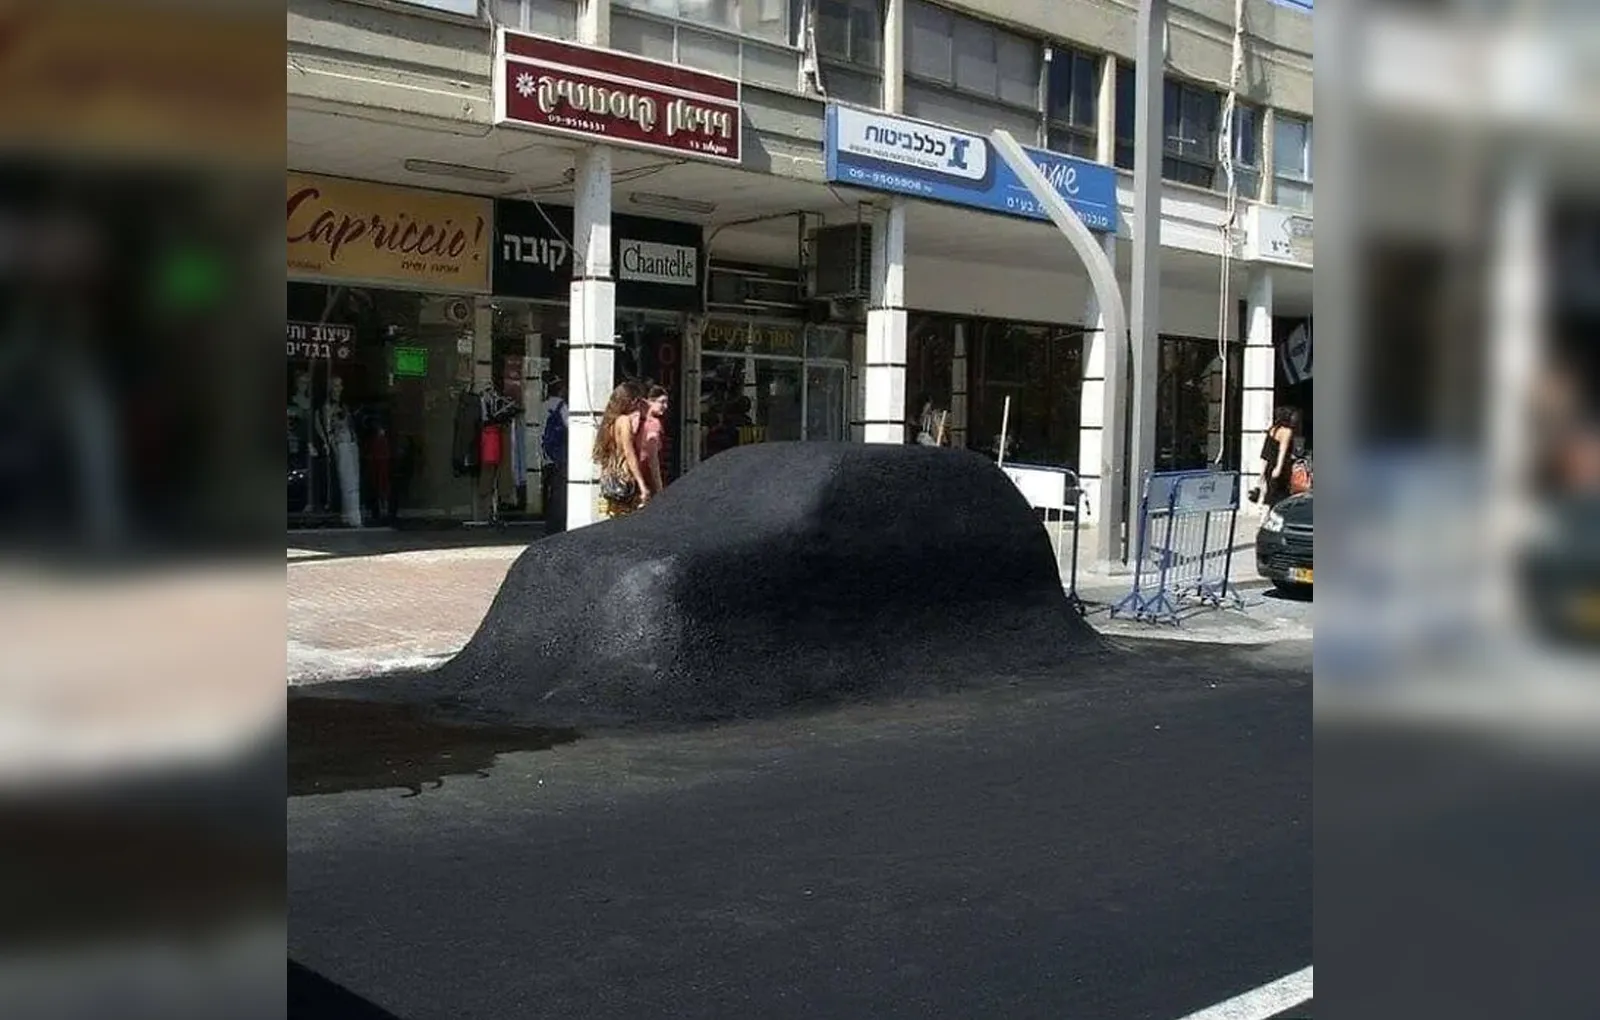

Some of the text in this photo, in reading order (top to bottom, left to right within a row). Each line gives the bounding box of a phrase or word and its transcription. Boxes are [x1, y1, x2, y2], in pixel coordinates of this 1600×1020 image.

[538, 75, 656, 132] קוסמטיק
[623, 243, 694, 278] Chantelle
[311, 325, 351, 343] עיצוב
